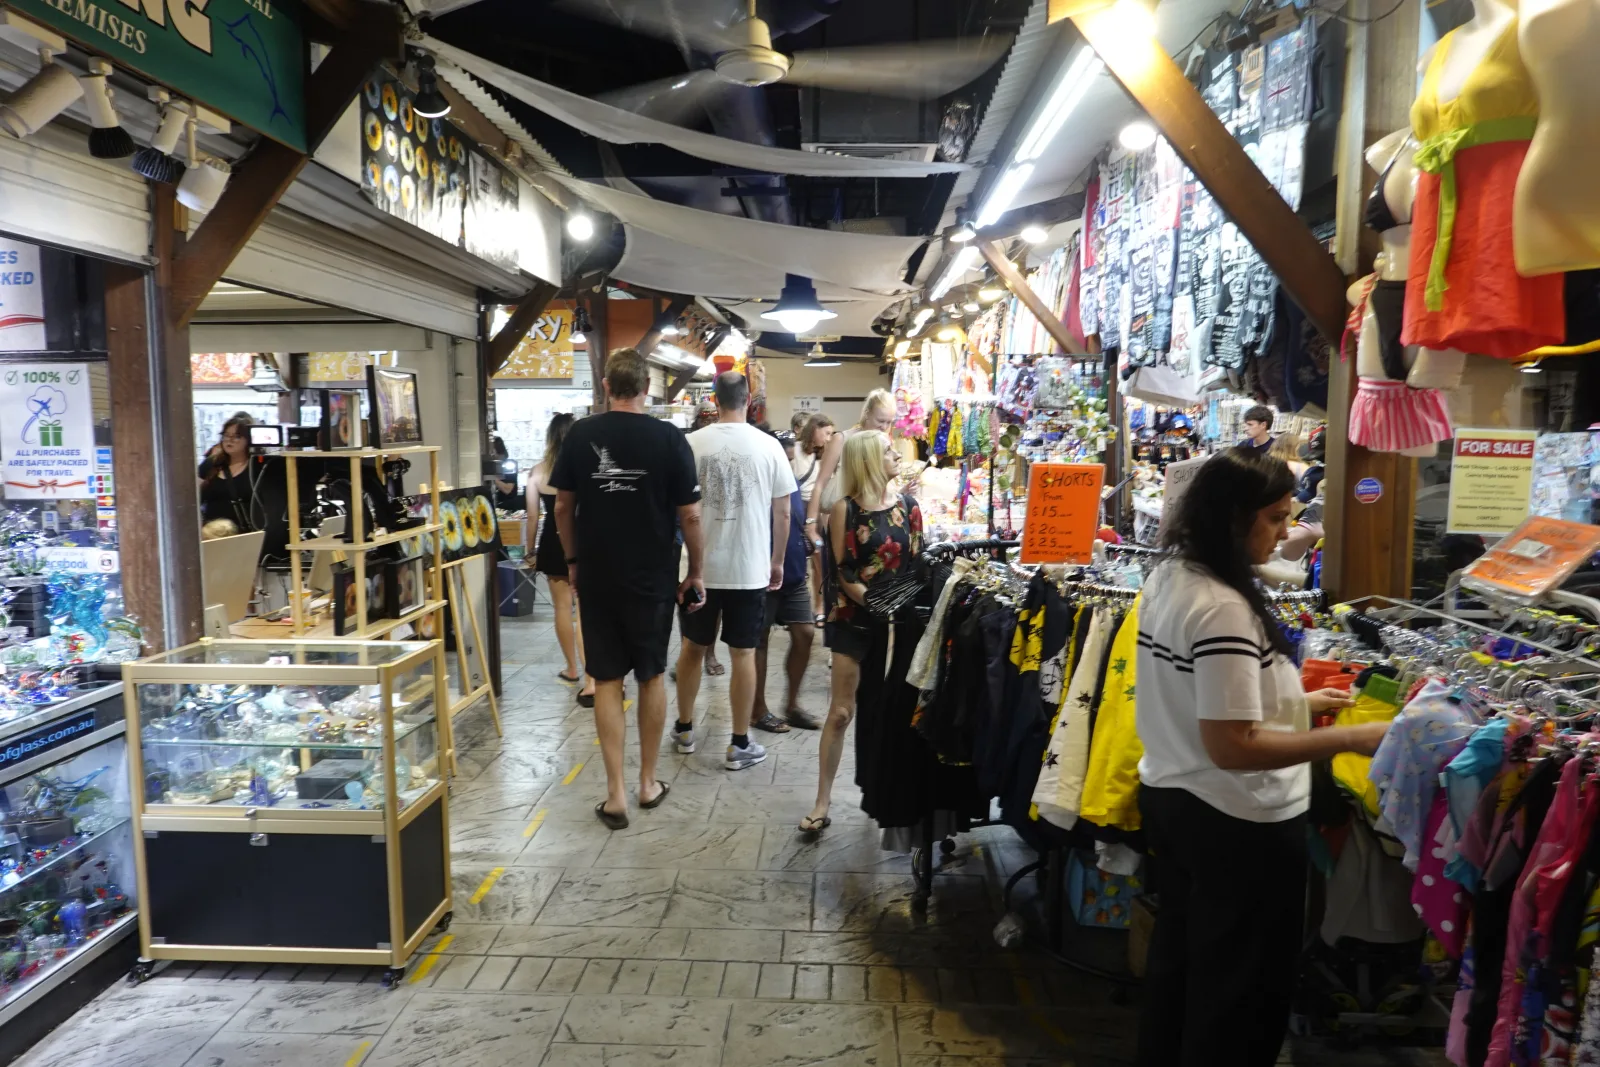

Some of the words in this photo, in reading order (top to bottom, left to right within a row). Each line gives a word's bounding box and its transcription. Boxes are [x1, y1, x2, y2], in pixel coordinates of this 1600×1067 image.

[42, 0, 147, 54] EMISES
[0, 271, 34, 286] KED
[526, 314, 562, 343] RY
[22, 371, 61, 383] 100%
[32, 449, 81, 457] PURCHASES
[1460, 440, 1490, 454] FOR
[1492, 441, 1532, 455] SALE
[1039, 471, 1095, 488] SHORTS
[0, 718, 95, 763] ofglass.com.au
